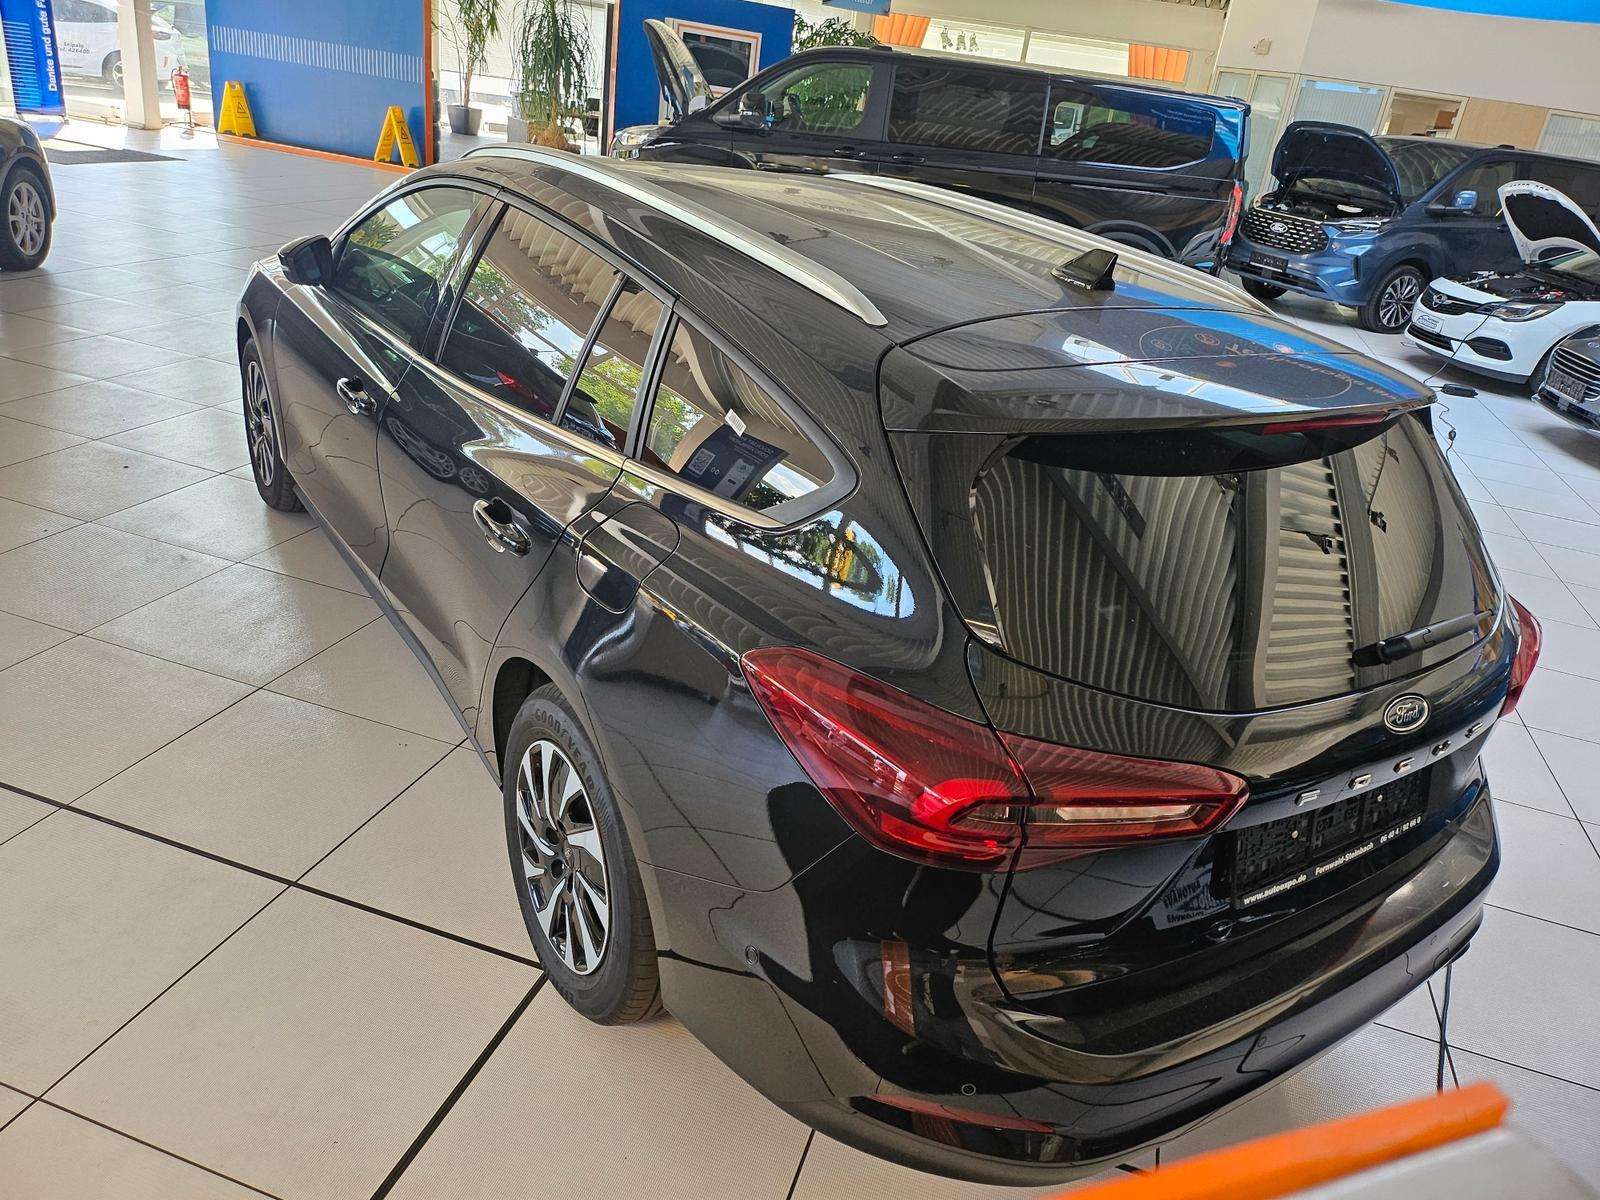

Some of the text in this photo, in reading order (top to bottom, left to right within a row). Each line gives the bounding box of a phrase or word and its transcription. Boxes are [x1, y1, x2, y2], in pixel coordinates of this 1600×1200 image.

[39, 11, 52, 35] gute
[42, 37, 53, 57] und
[47, 59, 58, 92] Danke
[1243, 874, 1307, 905] www.autoexpo.de
[1315, 842, 1374, 875] Fernwald-Steinbach
